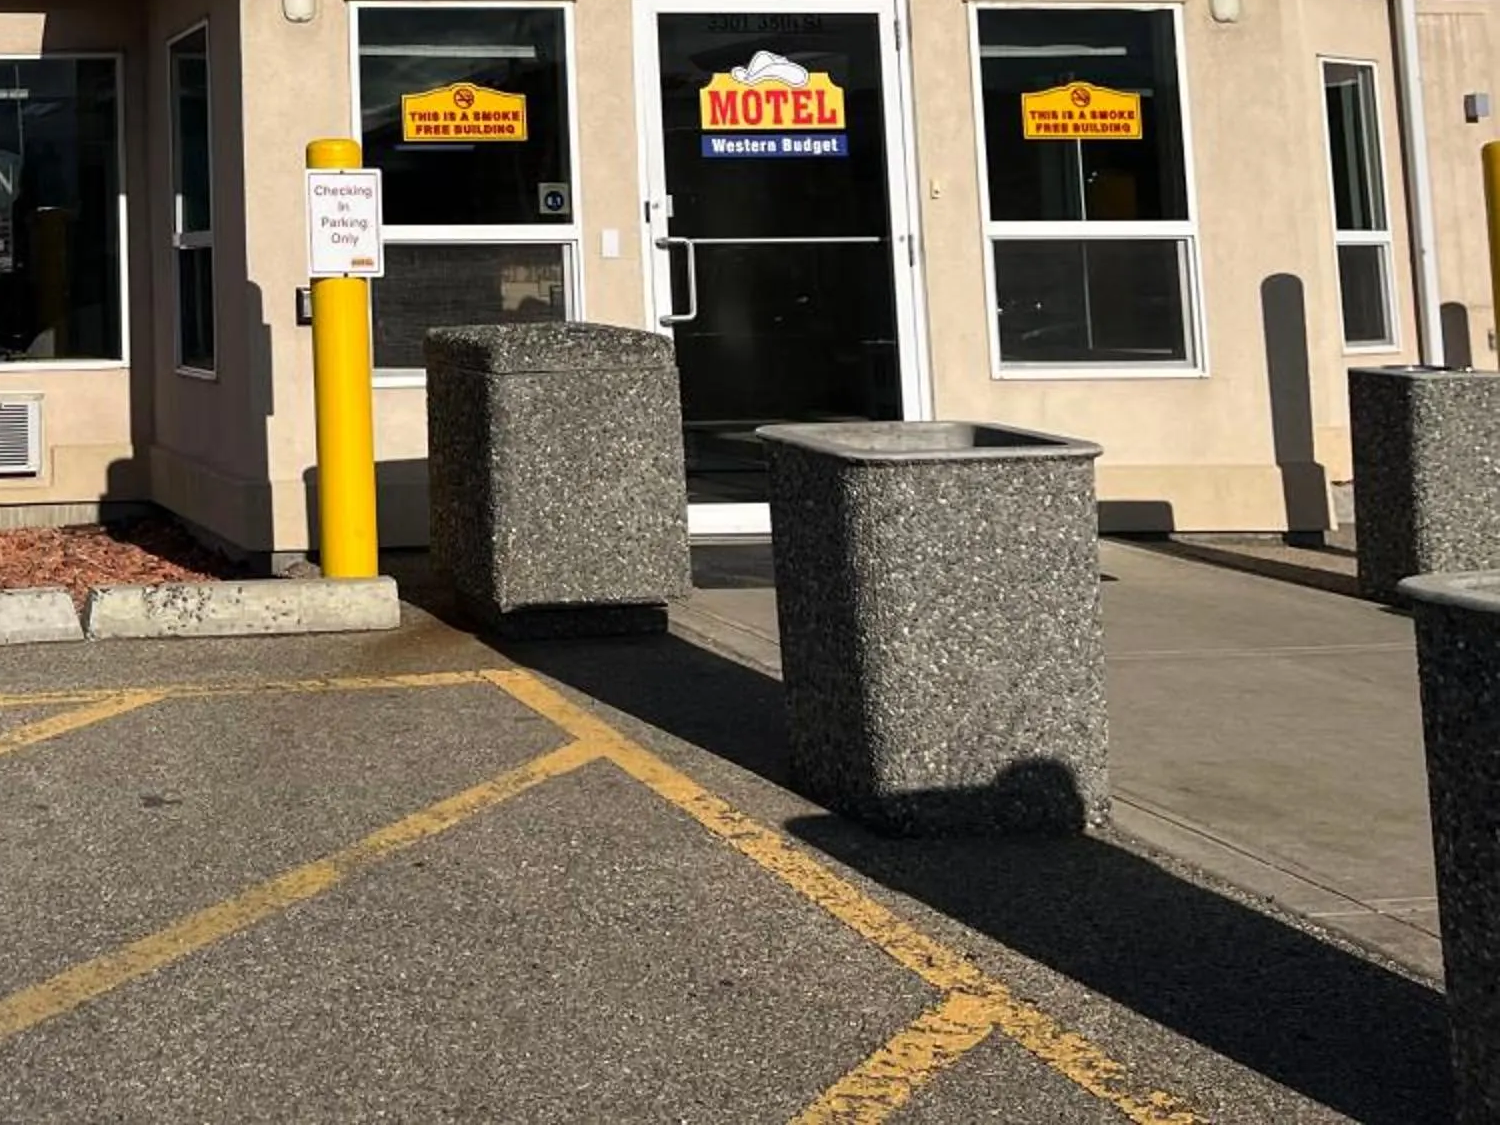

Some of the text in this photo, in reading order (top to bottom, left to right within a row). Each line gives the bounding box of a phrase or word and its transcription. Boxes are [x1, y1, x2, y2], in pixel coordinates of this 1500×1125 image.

[708, 89, 837, 125] MOTEL
[409, 111, 520, 121] THIS IS A SMOKE
[1029, 110, 1135, 120] THIS IS A SMOKE
[415, 124, 515, 135] FREE BUILDING
[1035, 123, 1131, 133] FREE BUILDING
[711, 138, 839, 155] Western Budget
[313, 184, 373, 200] Checking
[321, 217, 369, 232] Parking
[331, 232, 359, 247] Only
